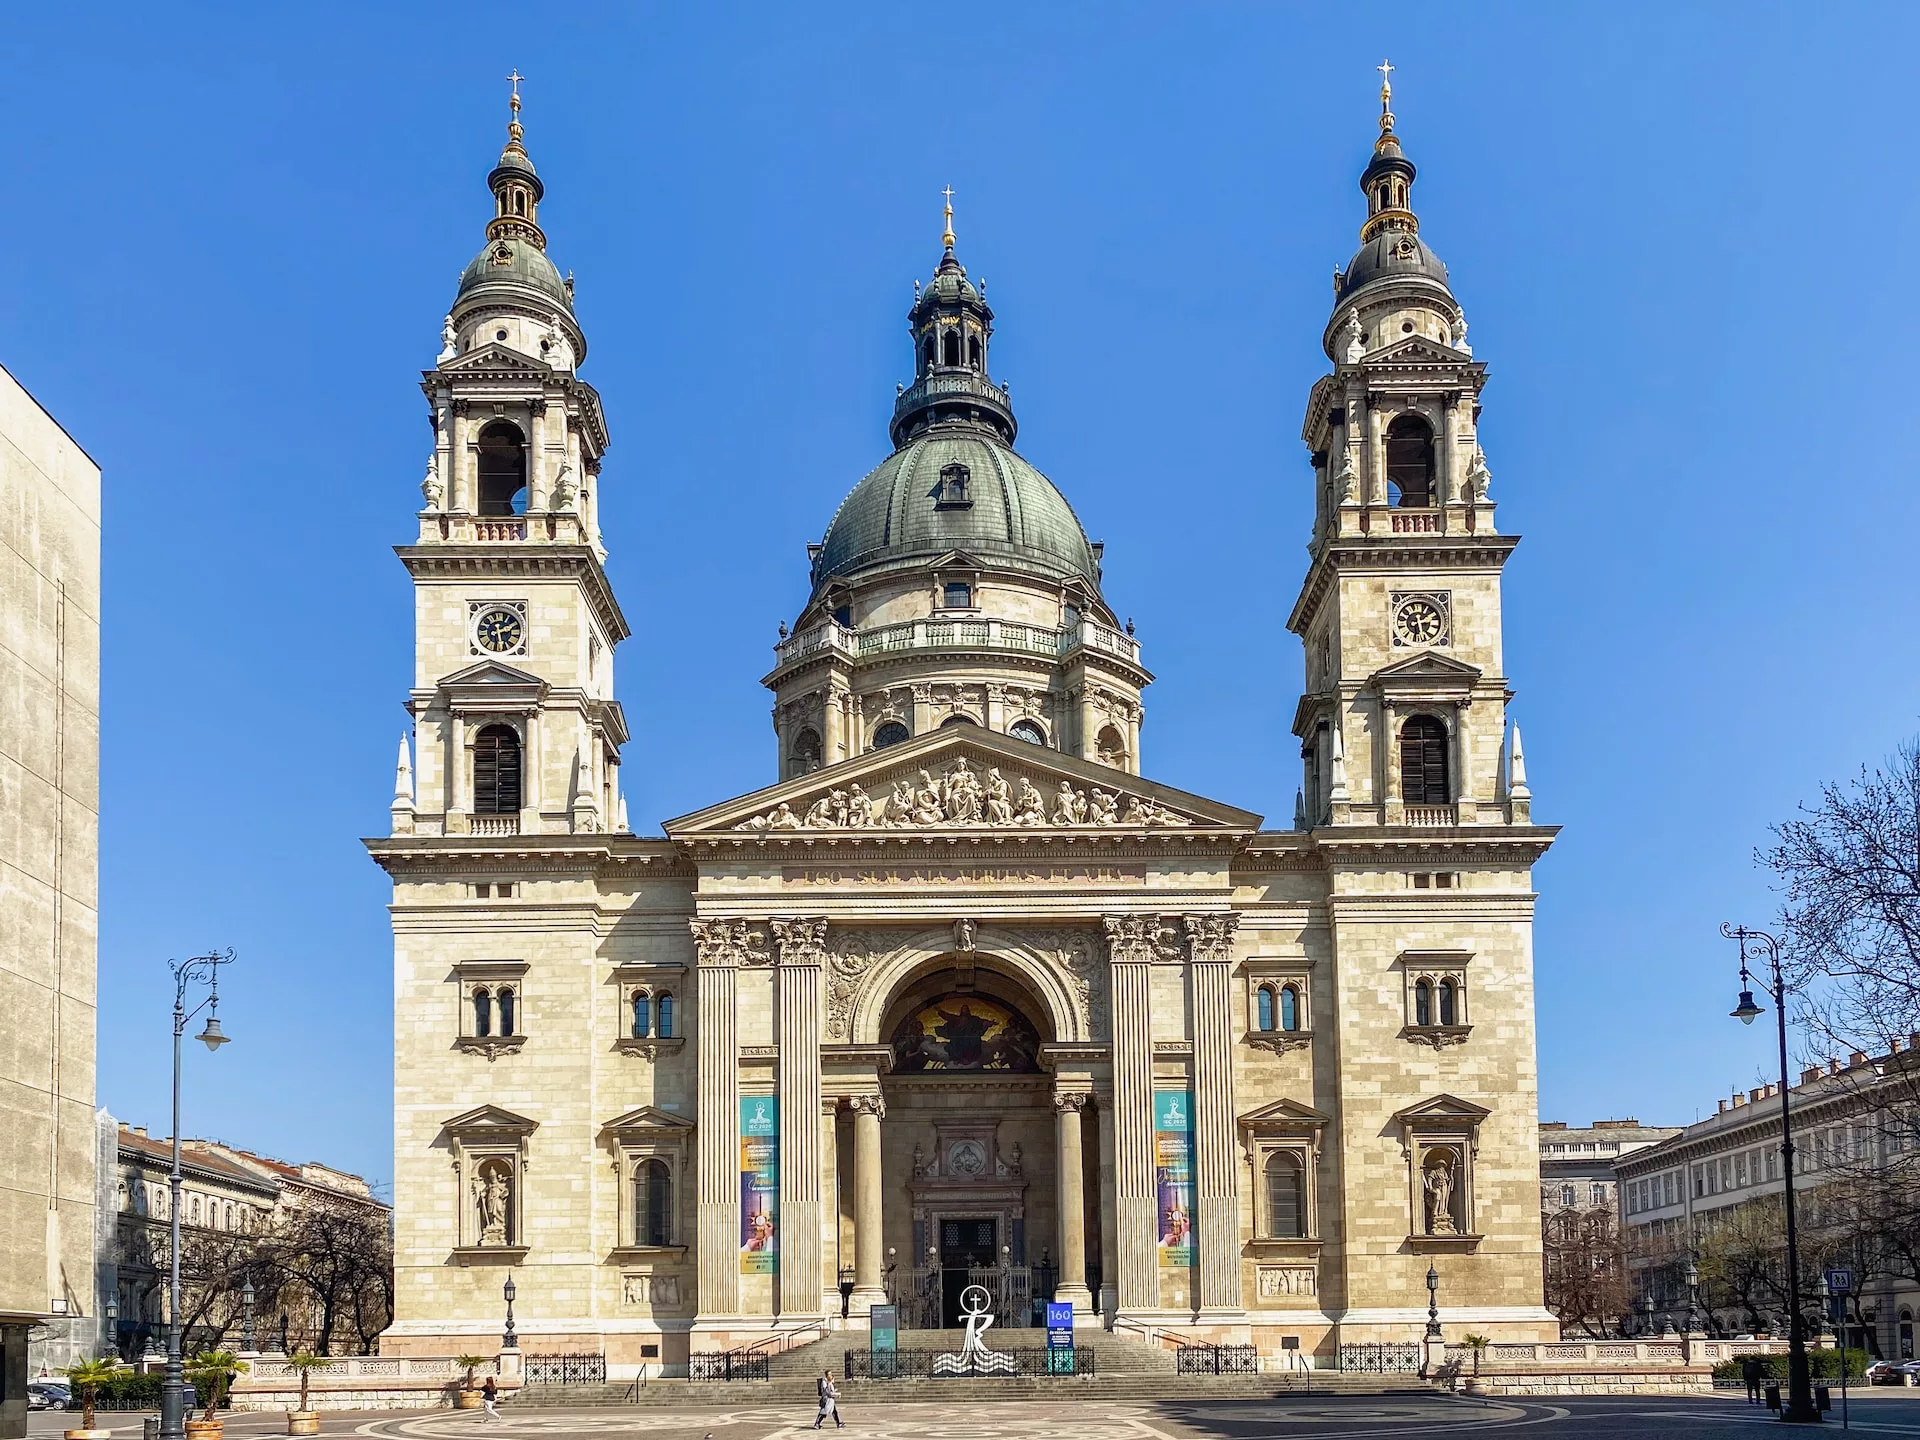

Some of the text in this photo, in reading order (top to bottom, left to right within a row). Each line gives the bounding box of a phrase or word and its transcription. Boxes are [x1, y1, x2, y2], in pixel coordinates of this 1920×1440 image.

[803, 868, 1125, 885] EGO SUM VIA VERITAS ET VITA
[1050, 1310, 1071, 1320] 160
